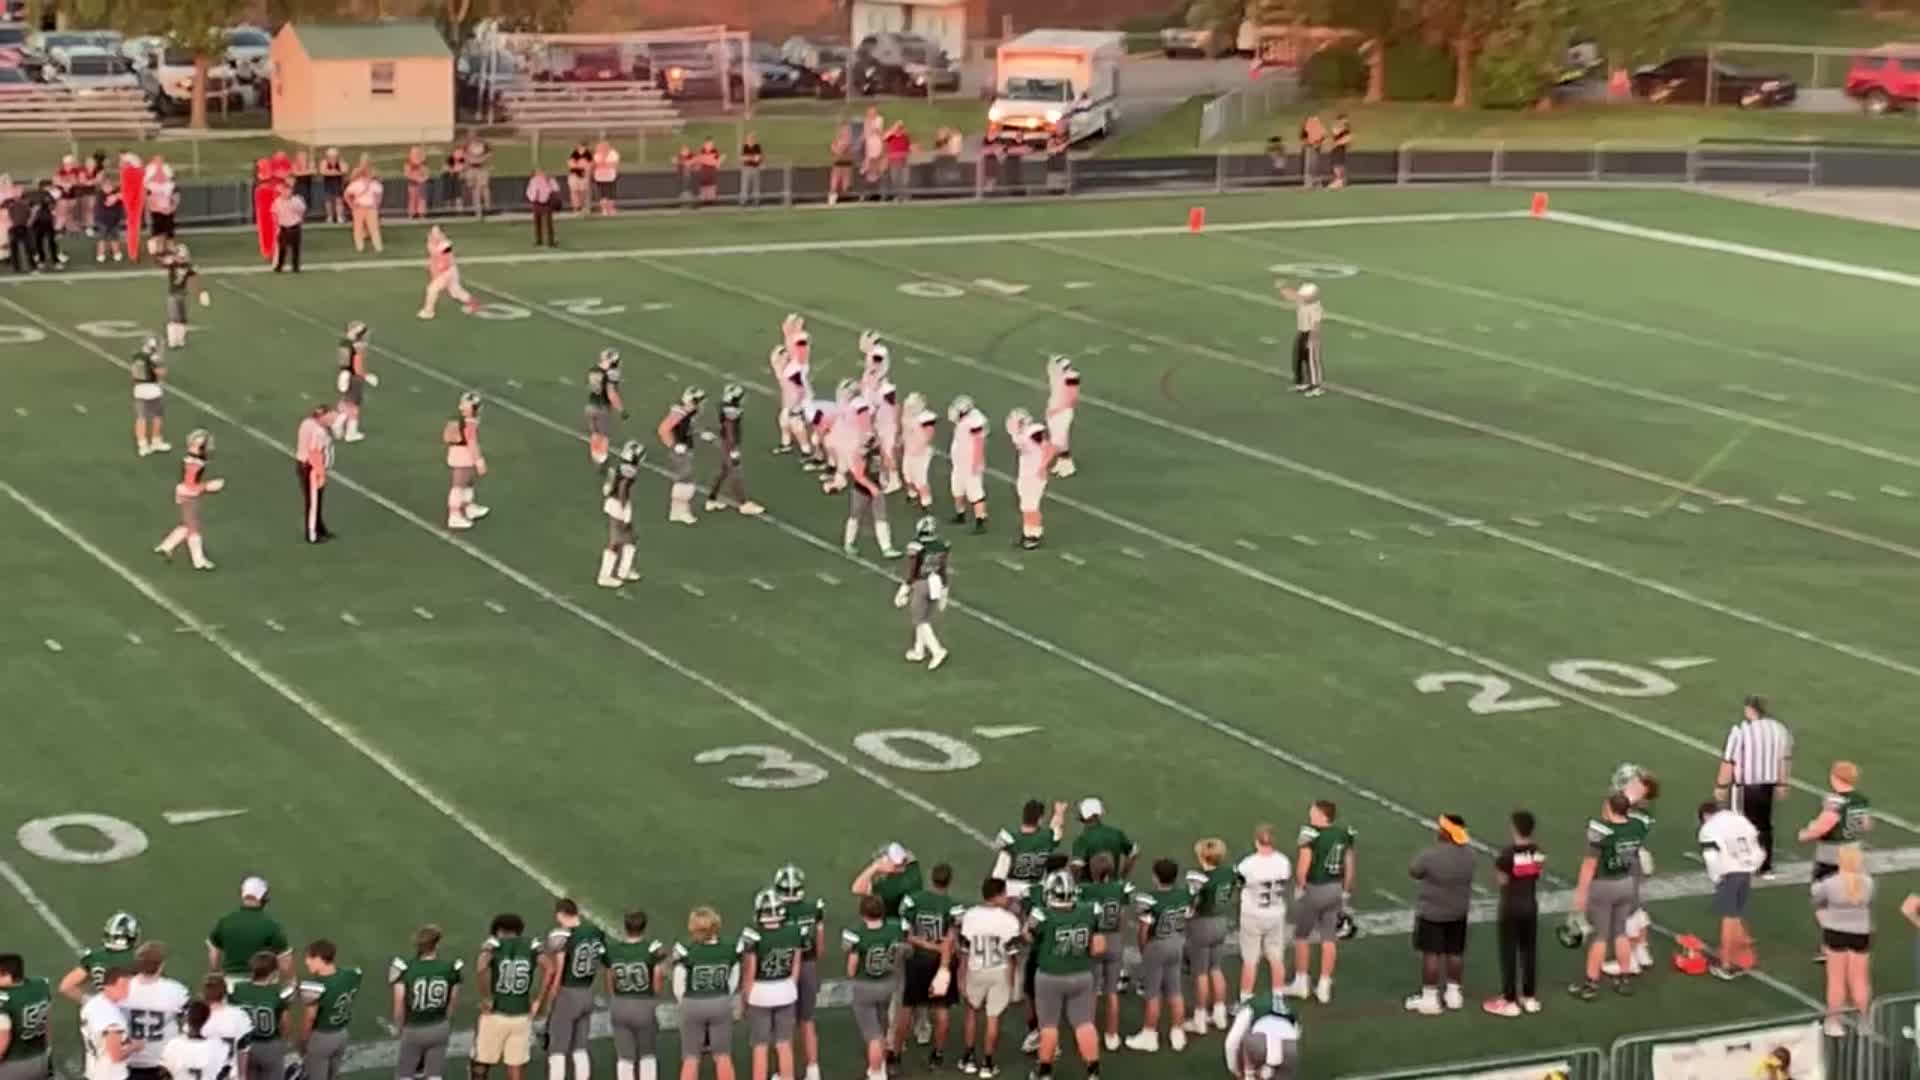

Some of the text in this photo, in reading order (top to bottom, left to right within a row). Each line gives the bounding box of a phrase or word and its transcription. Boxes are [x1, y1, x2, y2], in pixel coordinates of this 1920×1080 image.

[1414, 658, 1678, 714] 20
[695, 729, 982, 789] 30
[412, 976, 448, 1010] 19
[496, 958, 530, 994] 16
[130, 1009, 165, 1040] 62
